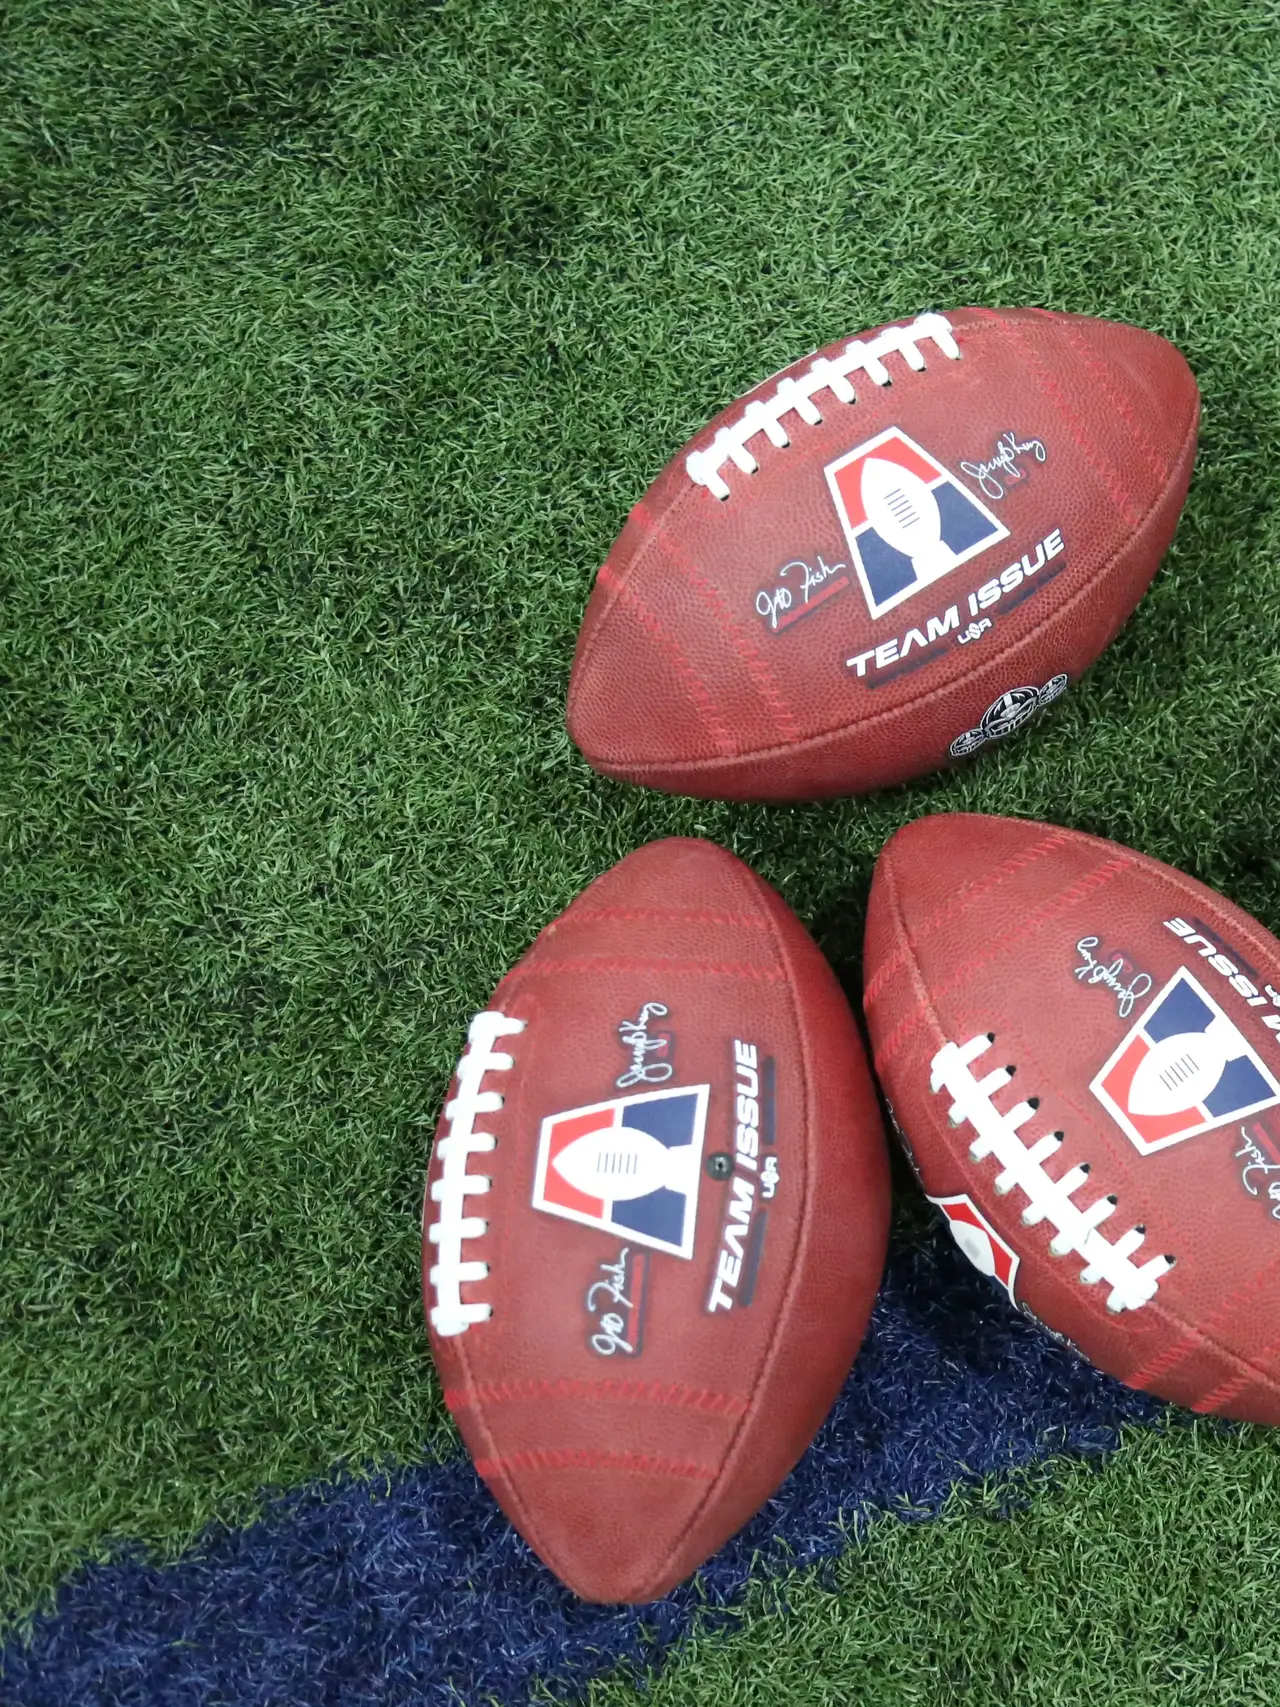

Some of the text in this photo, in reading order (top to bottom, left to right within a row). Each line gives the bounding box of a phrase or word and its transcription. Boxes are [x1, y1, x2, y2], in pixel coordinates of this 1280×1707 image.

[846, 528, 1065, 677] TEAM ISSUE
[957, 618, 992, 645] USA
[1163, 917, 1268, 1007] ISSUE
[708, 1039, 760, 1312] TEAM ISSUE
[760, 1155, 780, 1198] USA
